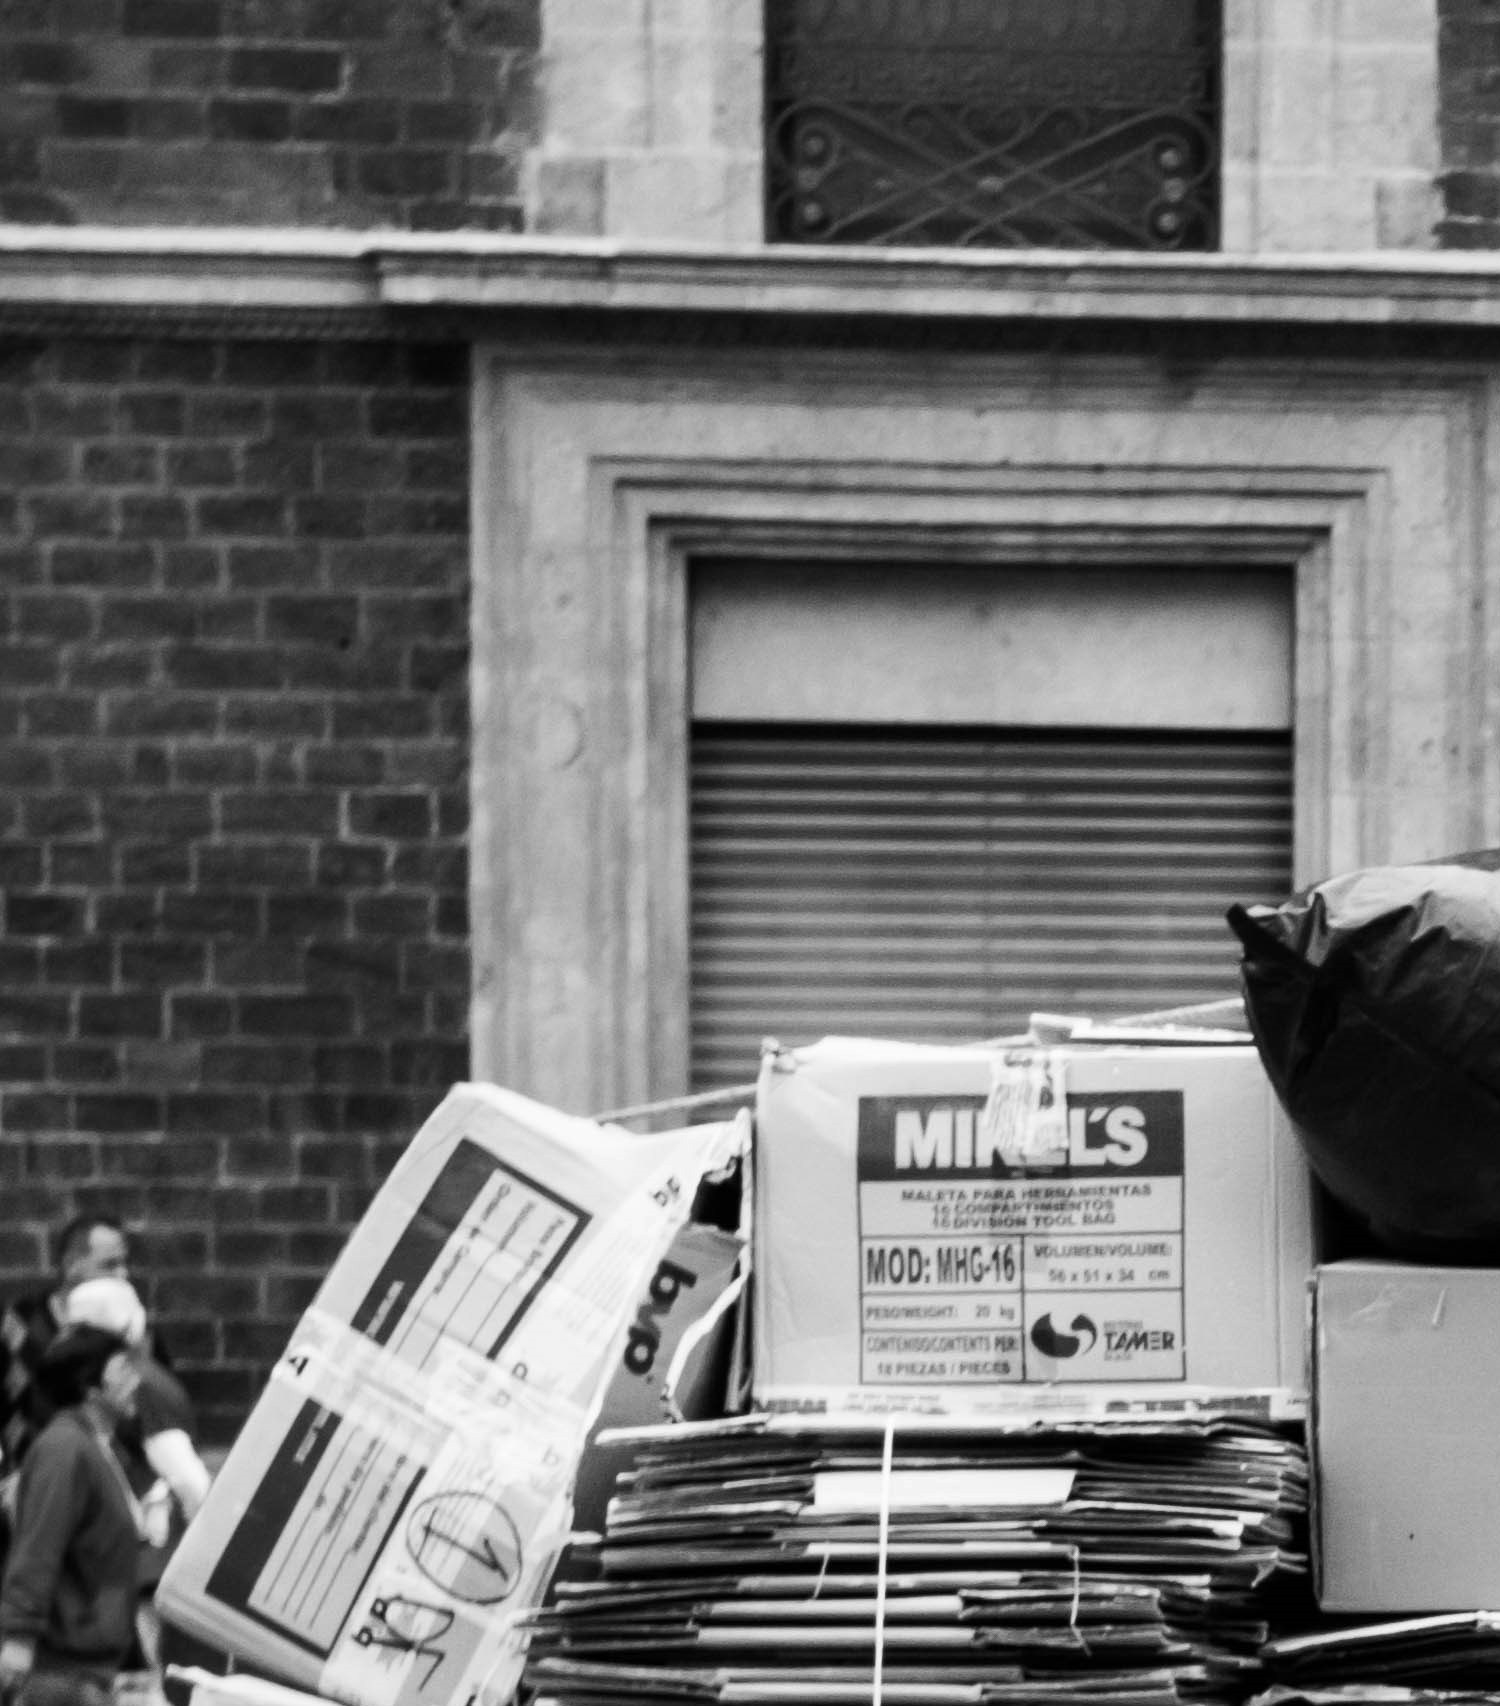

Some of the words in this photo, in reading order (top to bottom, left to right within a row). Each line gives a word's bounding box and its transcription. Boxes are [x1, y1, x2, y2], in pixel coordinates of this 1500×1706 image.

[867, 1247, 931, 1285] MOD:
[936, 1243, 1015, 1284] MHG-16
[1103, 1331, 1175, 1352] TAMER
